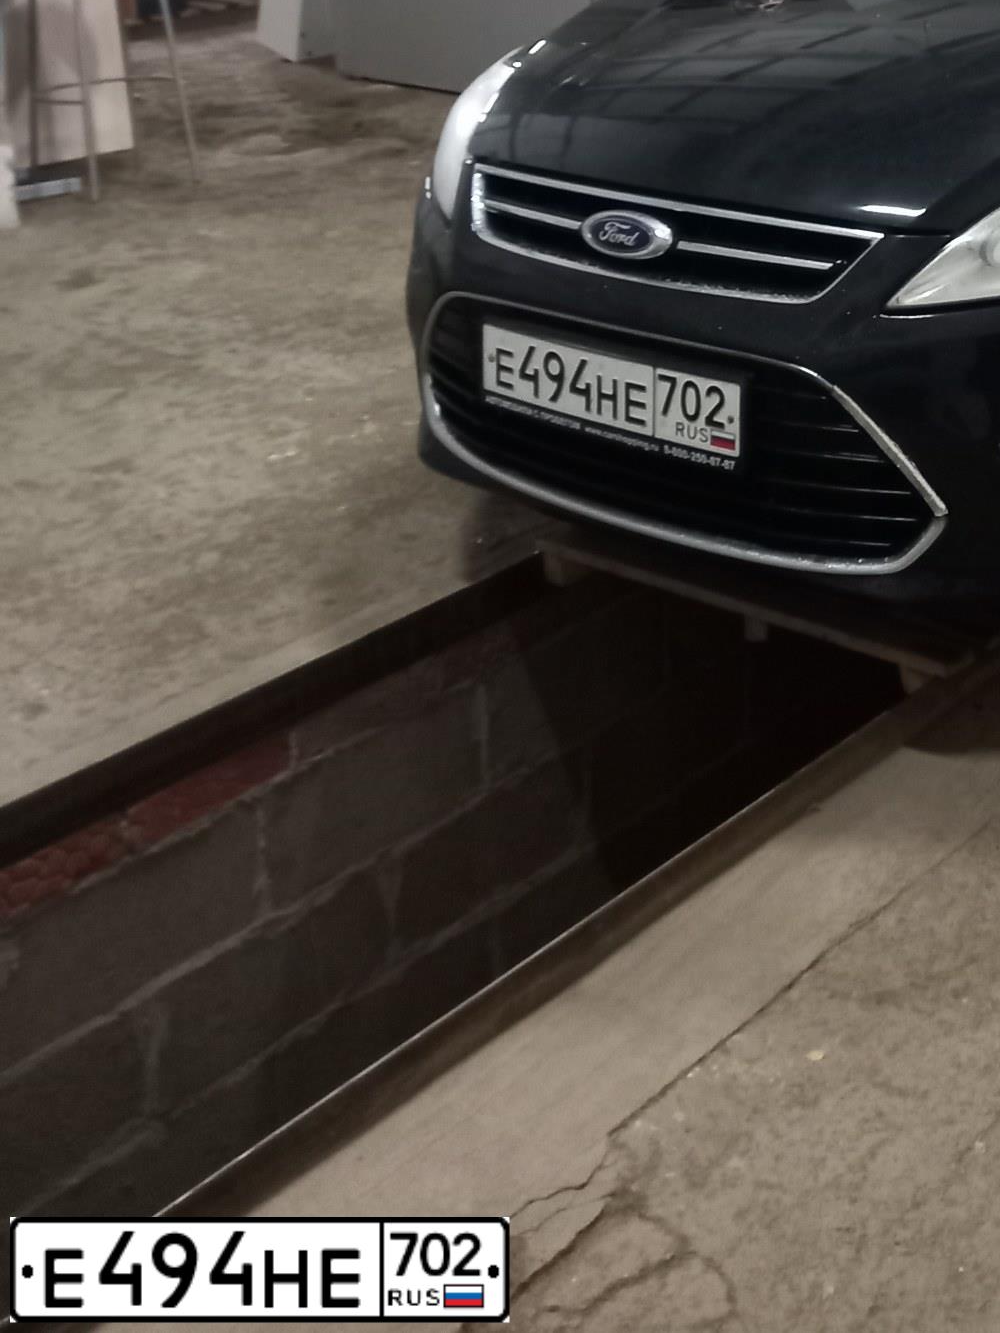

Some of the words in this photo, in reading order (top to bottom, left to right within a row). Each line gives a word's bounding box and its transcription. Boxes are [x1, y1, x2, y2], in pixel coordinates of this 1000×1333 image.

[599, 221, 640, 247] Ford
[658, 373, 726, 429] 702
[675, 421, 709, 443] RUS
